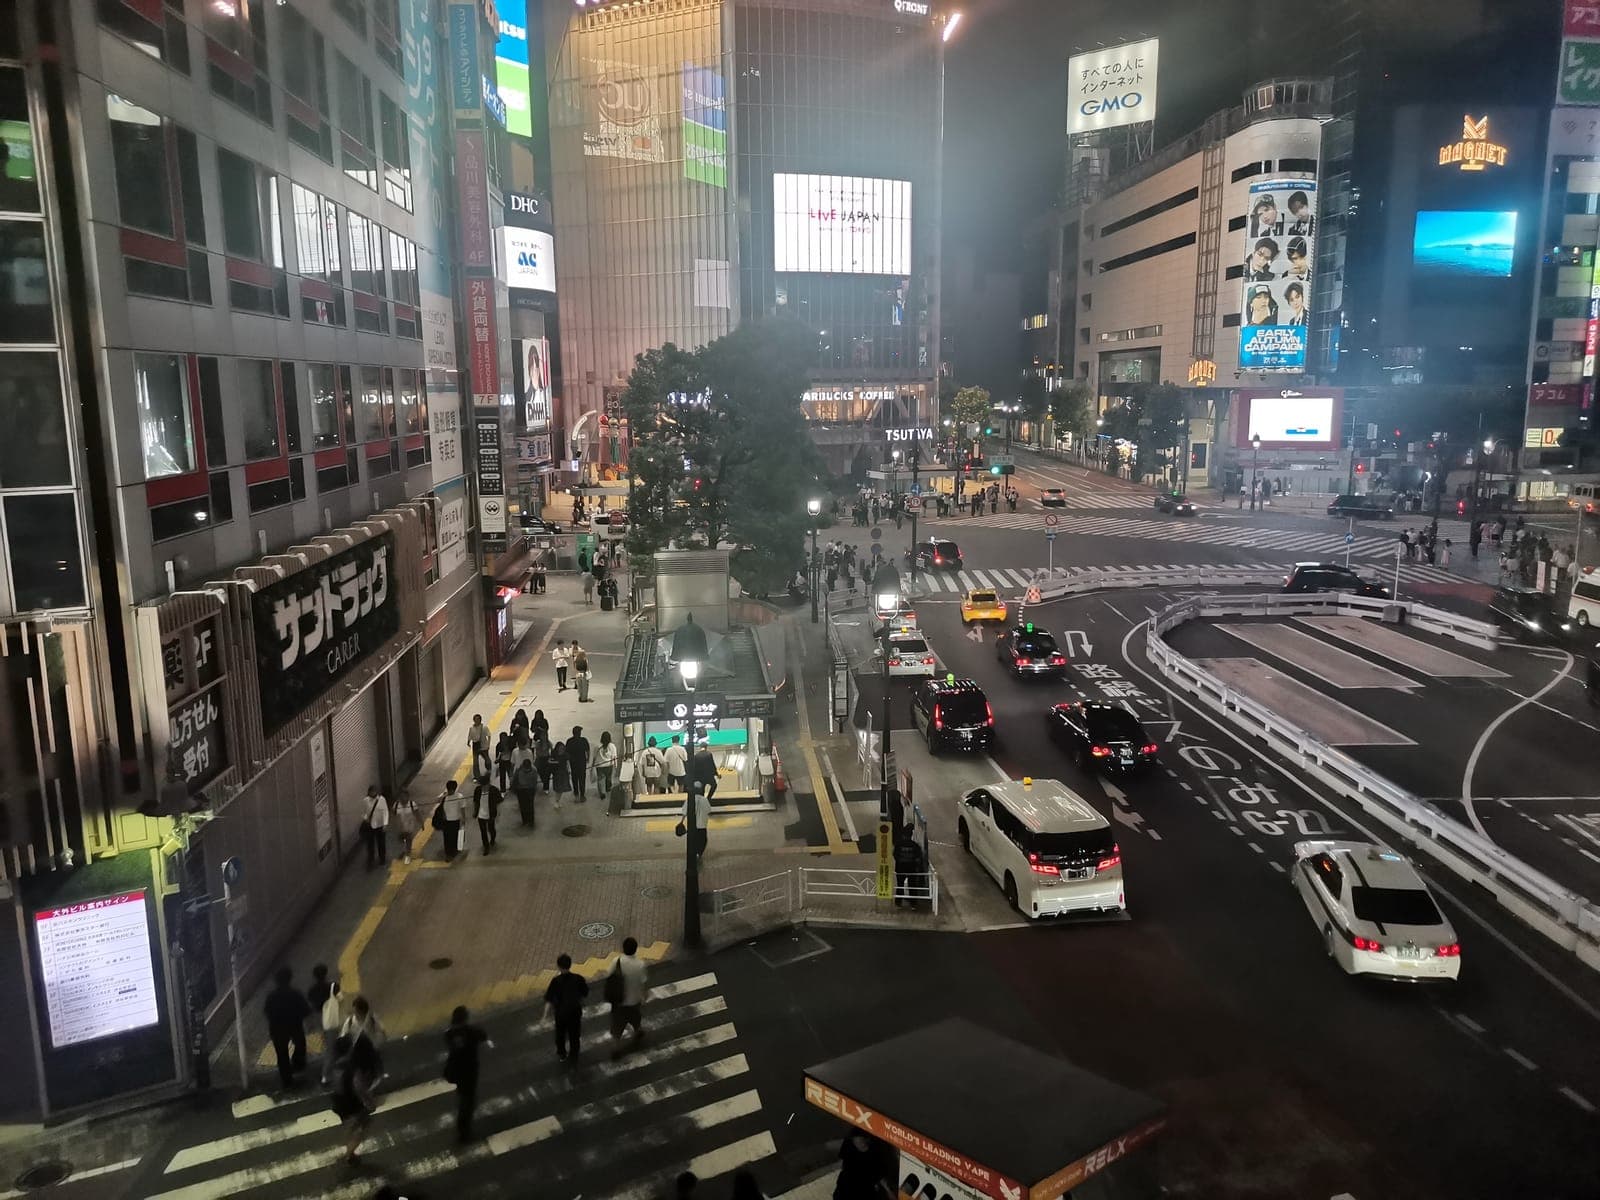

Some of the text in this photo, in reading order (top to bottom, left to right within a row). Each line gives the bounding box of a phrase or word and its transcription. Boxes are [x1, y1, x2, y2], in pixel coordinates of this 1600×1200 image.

[1081, 58, 1144, 80] すべての人に
[1081, 73, 1143, 94] インターネット
[1081, 92, 1142, 116] GMO
[1439, 140, 1507, 166] MAGNET
[511, 195, 538, 214] DHC
[810, 208, 880, 223] LIVE JAPAN
[472, 281, 489, 343] 外貨両替
[1249, 336, 1301, 344] AUTUMN
[1256, 329, 1296, 337] EARLY
[1244, 343, 1304, 352] CAMPAIGN
[478, 395, 494, 405] 7F
[1535, 389, 1566, 401] アコム
[273, 545, 388, 671] サンドラッグ
[182, 735, 210, 784] 受付
[807, 1081, 873, 1130] RELX
[884, 1120, 920, 1146] WORLD'S
[922, 1140, 961, 1167] LEADING
[964, 1161, 991, 1181] VAPE
[1084, 1136, 1127, 1177] RELX
